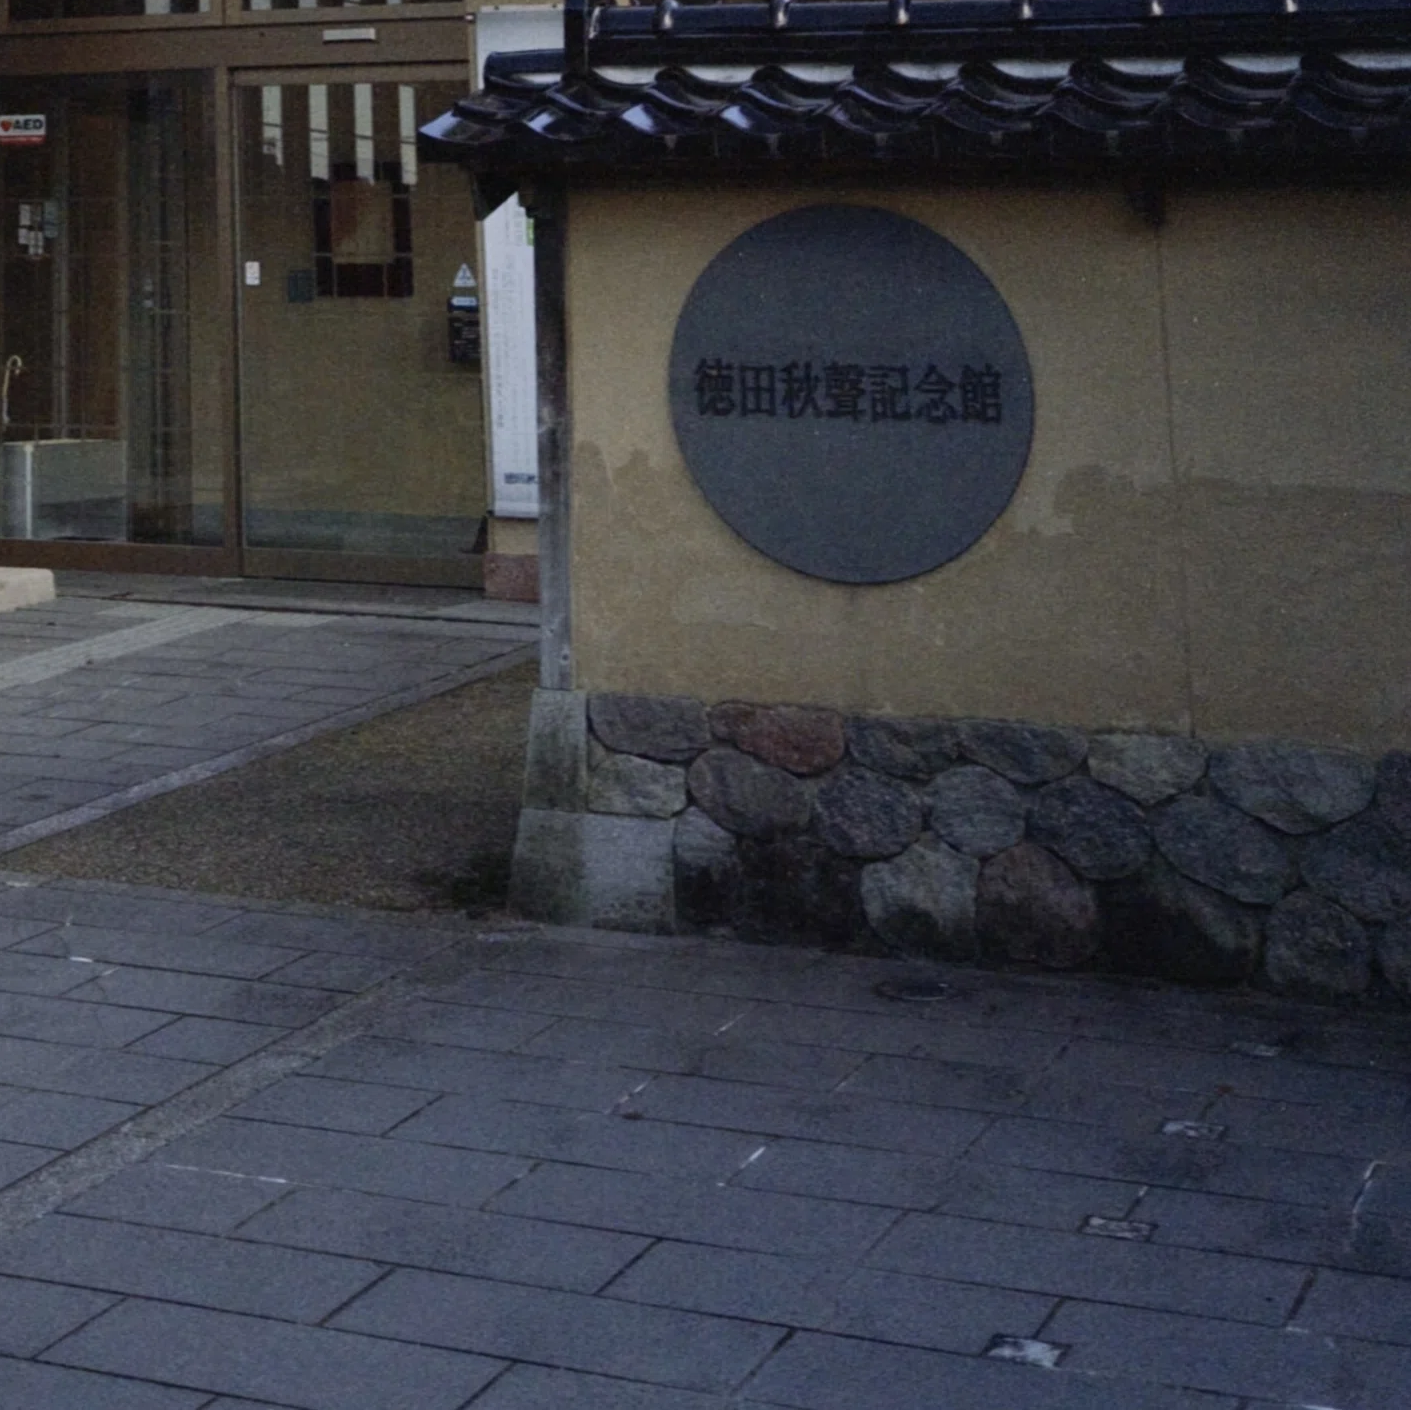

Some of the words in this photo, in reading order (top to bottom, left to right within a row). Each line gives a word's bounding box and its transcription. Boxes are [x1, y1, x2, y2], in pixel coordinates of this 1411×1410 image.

[13, 118, 44, 130] AED
[693, 357, 1003, 426] 徳田秋聲記念館
